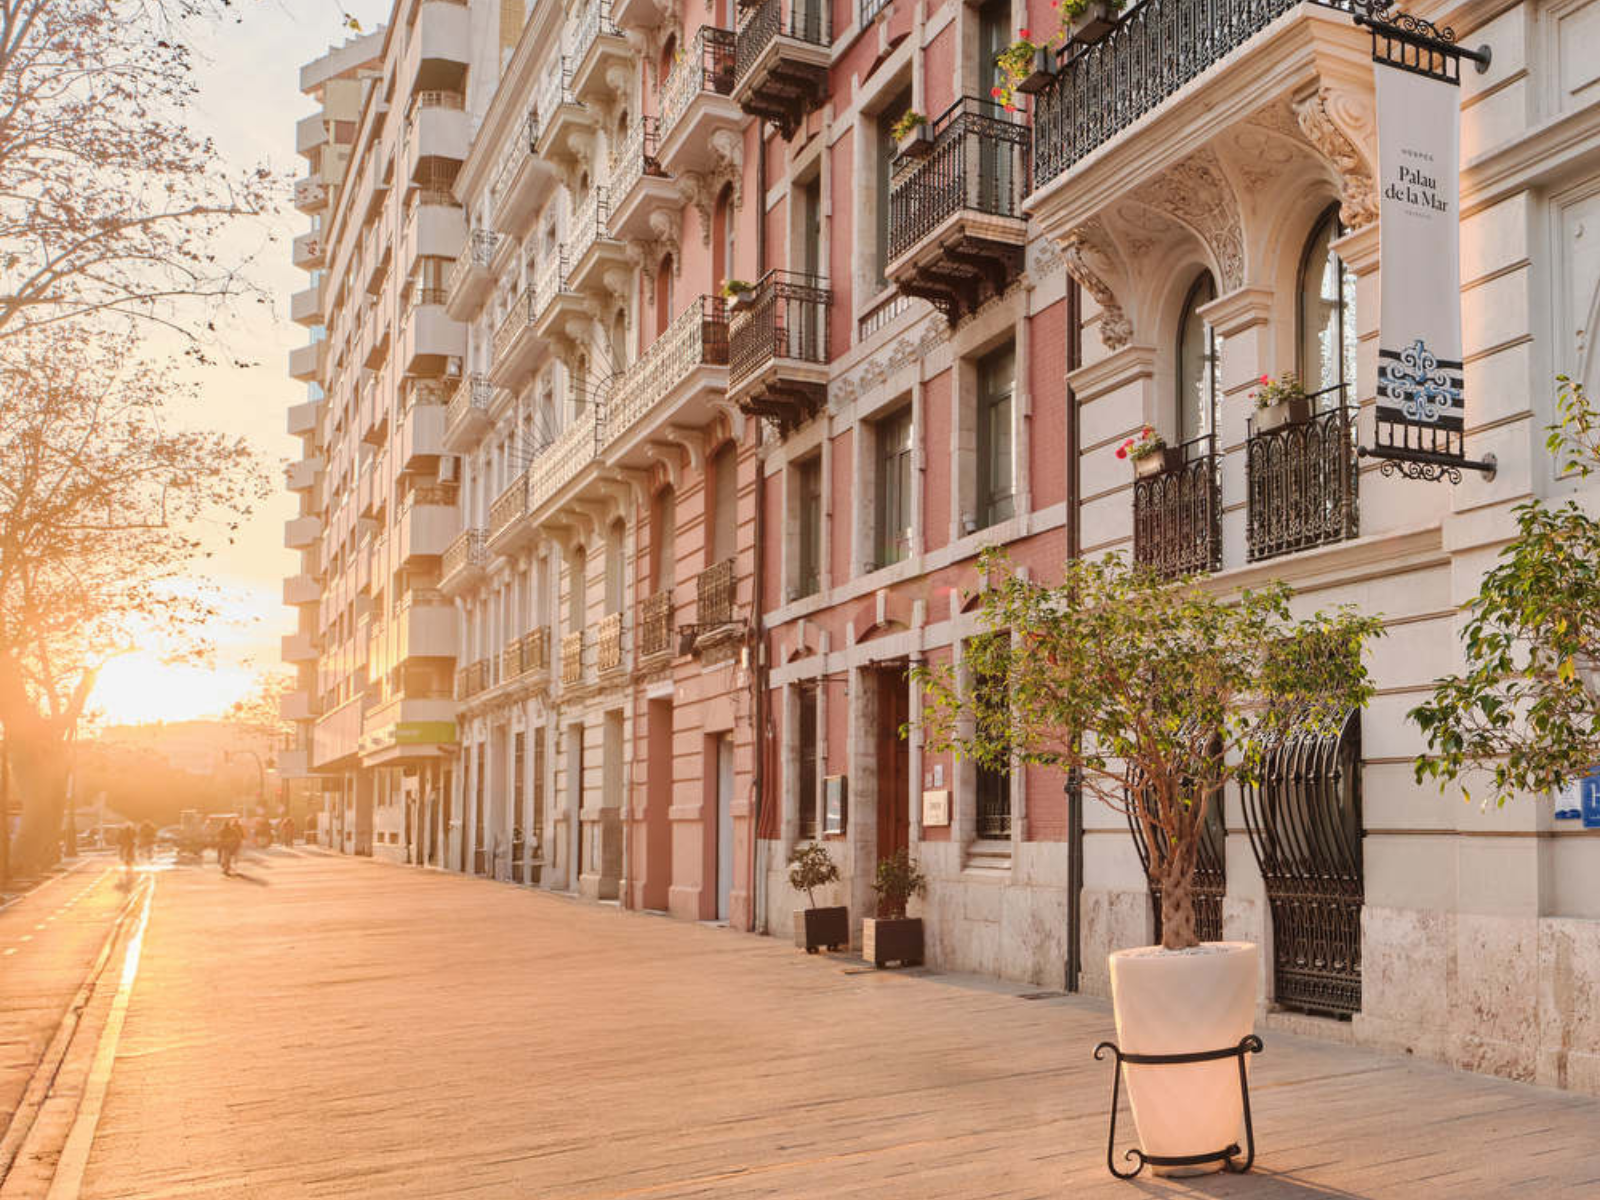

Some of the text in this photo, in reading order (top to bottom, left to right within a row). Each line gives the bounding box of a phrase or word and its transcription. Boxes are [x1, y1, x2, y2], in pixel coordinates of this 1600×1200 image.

[1399, 165, 1436, 190] Palau
[1385, 183, 1449, 212] de la Mar
